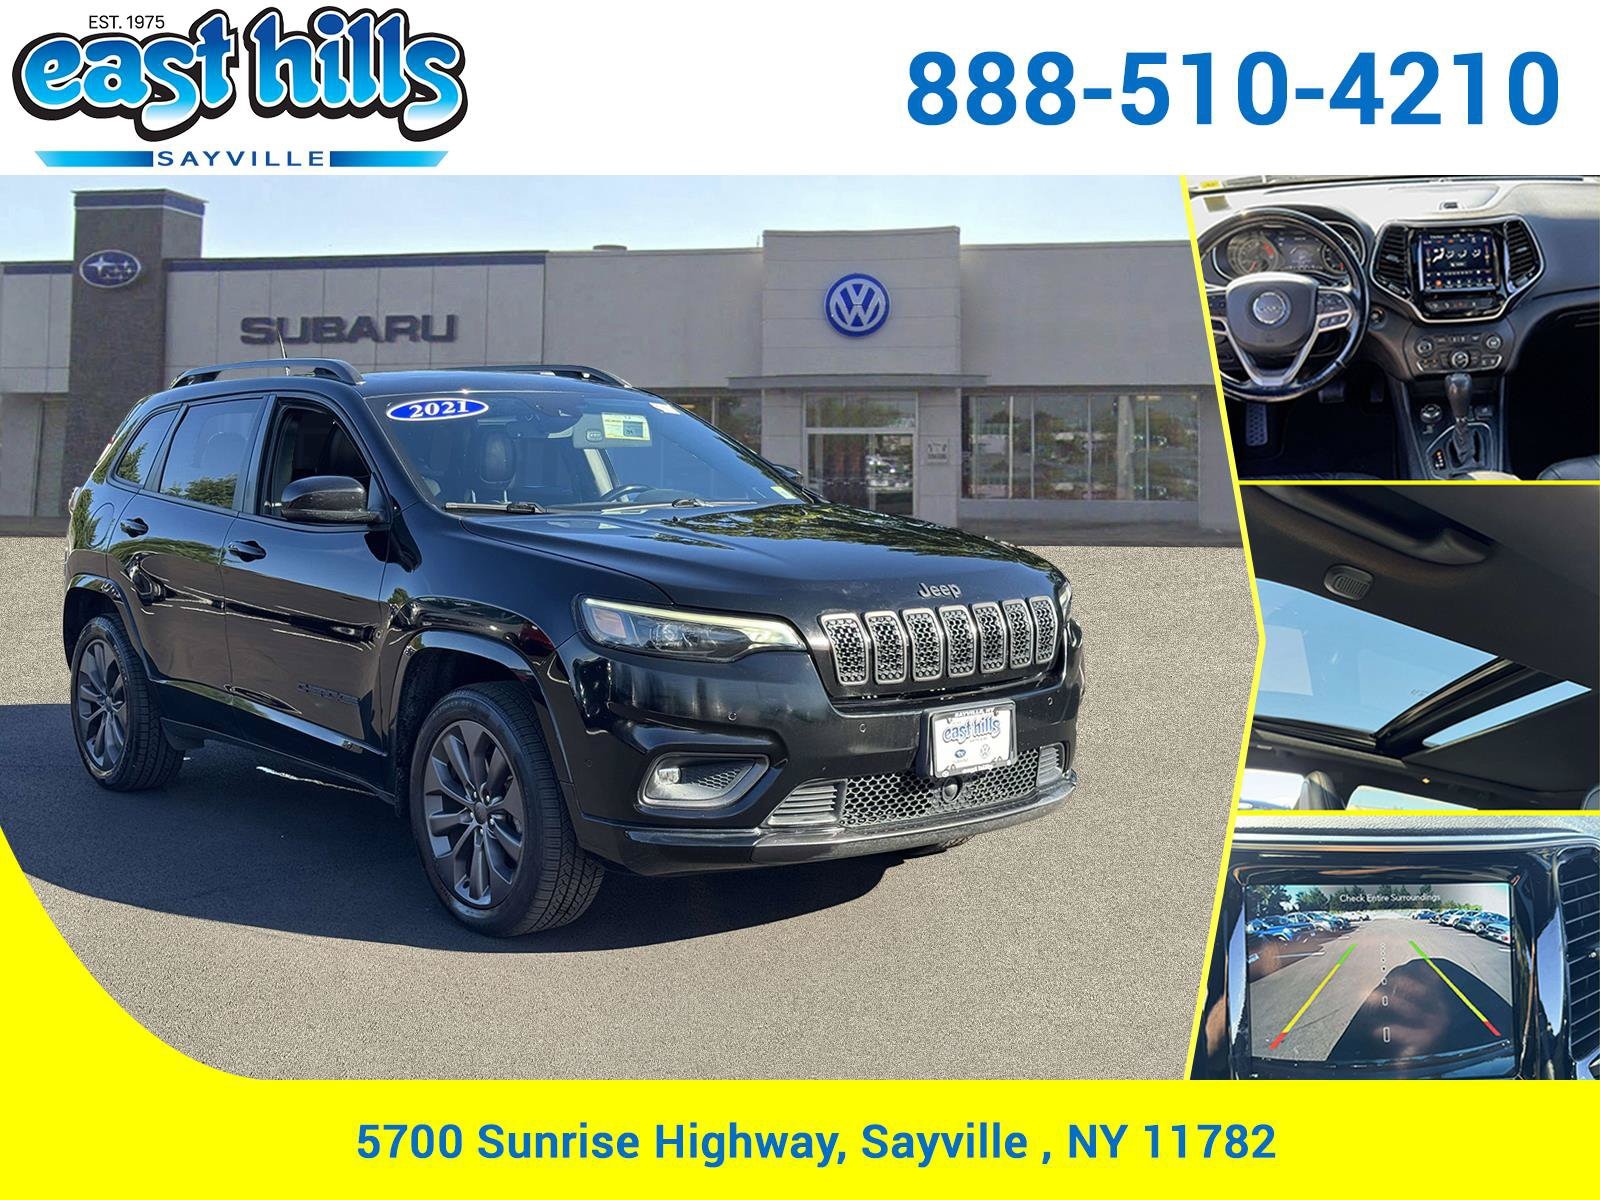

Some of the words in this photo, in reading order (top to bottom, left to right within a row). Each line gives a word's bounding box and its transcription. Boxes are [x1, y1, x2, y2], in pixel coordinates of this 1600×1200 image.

[240, 314, 458, 345] SUBARU
[409, 401, 469, 418] 2021
[917, 582, 961, 599] Jeep
[942, 720, 972, 745] east
[973, 715, 1001, 739] hills
[1340, 893, 1365, 903] Check
[1367, 893, 1390, 903] Entire
[1391, 892, 1440, 903] Surroundings
